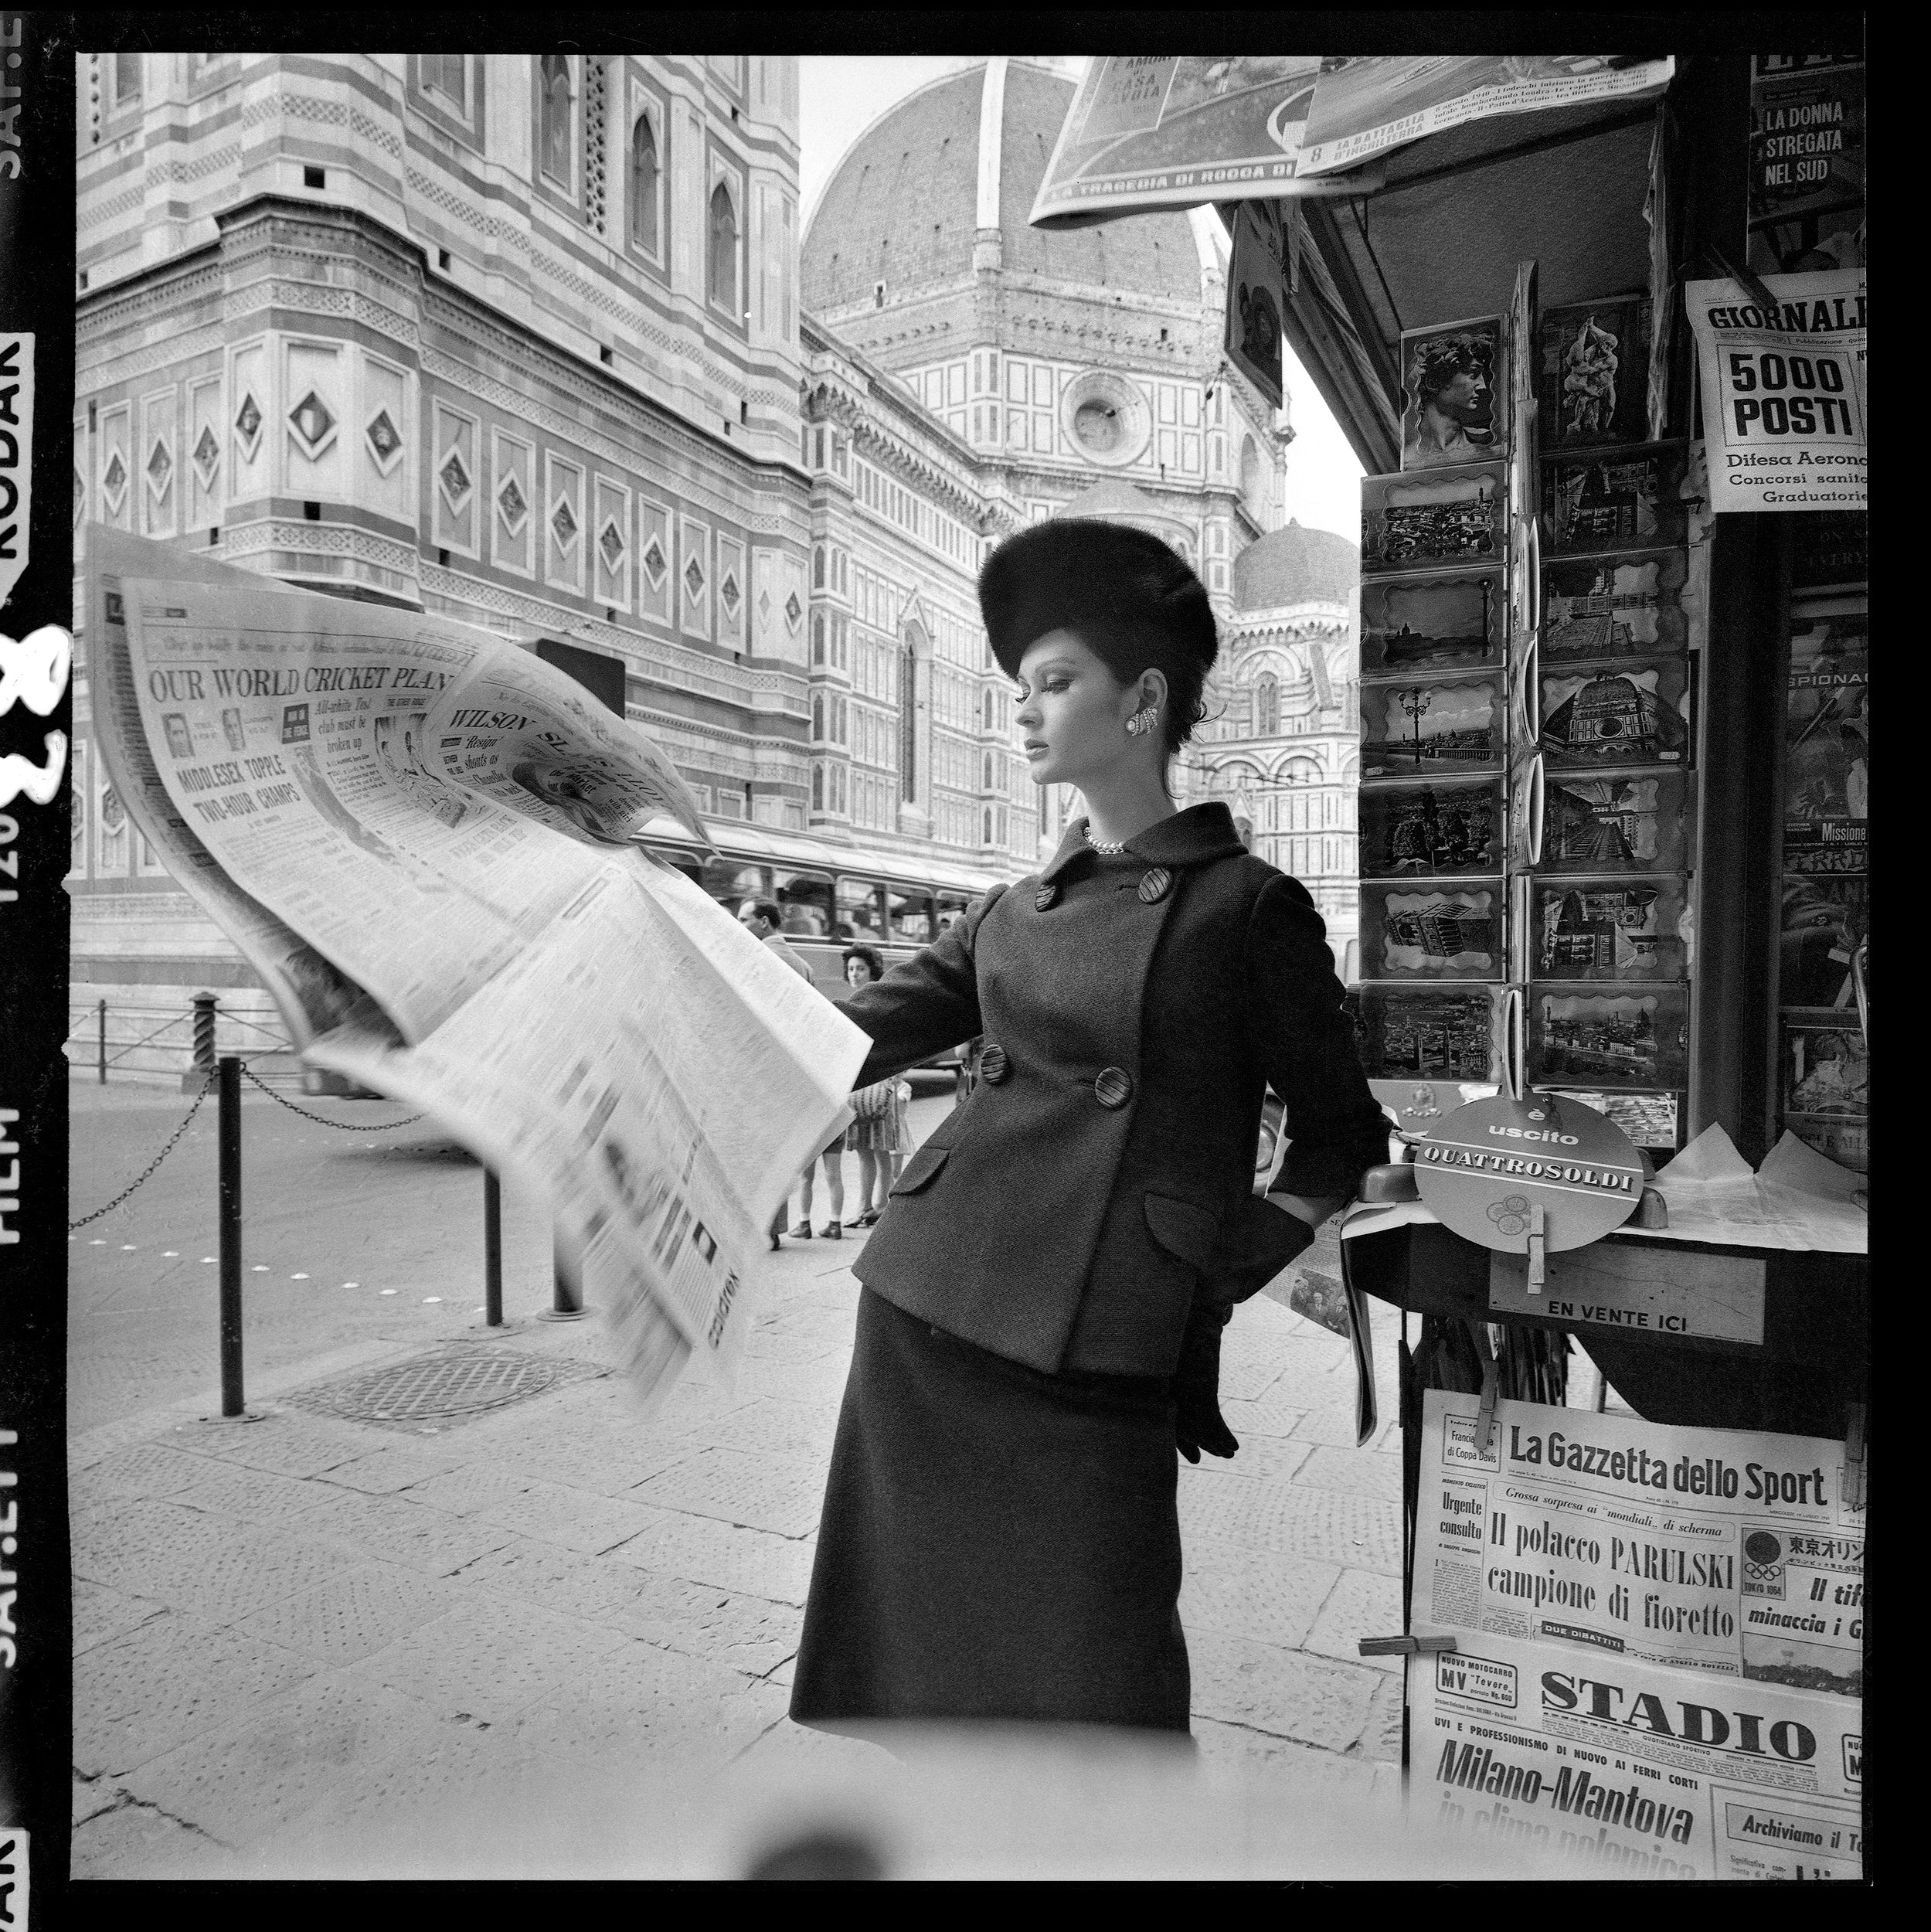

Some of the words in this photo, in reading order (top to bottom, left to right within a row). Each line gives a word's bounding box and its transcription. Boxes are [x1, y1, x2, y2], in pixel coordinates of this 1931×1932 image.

[1472, 90, 1490, 100] 1940
[1501, 83, 1538, 94] tedeschi
[1541, 79, 1575, 88] iniziano
[1461, 92, 1518, 111] bombardando
[1766, 109, 1786, 131] LA
[1789, 101, 1843, 129] DONNA
[1311, 147, 1322, 162] 8
[1337, 139, 1349, 150] LA
[1354, 113, 1425, 144] BATTAGLIA
[1334, 123, 1423, 161] D'INGHILTERRA
[1766, 129, 1843, 158] STREGATA
[1081, 175, 1168, 195] TRAGEDIA
[1175, 172, 1194, 186] DI
[1202, 165, 1265, 184] ROCCA
[1273, 162, 1294, 178] DI
[1765, 162, 1793, 186] NEL
[1797, 159, 1828, 182] SUD
[1729, 353, 1844, 393] 5000
[1733, 396, 1853, 437] POSTI
[1726, 453, 1793, 468] Difesa
[1729, 474, 1807, 486] Concorsi
[149, 669, 206, 703] OUR
[212, 668, 299, 697] WORLD
[304, 667, 390, 692] CRICKET
[390, 667, 455, 692] PLAN
[338, 716, 355, 732] must
[450, 709, 537, 730] WILSON
[327, 737, 351, 753] broken
[353, 738, 362, 751] up
[464, 753, 488, 770] shouts
[490, 754, 499, 765] as
[177, 760, 246, 794] MIDDLESEX
[244, 754, 287, 780] TOPPLE
[194, 792, 259, 824] TWO-HOUR
[257, 783, 301, 809] CHAMPS
[620, 809, 634, 823] girl
[1822, 822, 1867, 841] Missione
[1528, 1106, 1545, 1122] è
[1488, 1123, 1579, 1146] uscito
[1423, 1145, 1635, 1192] QUATTROSOLDI
[1548, 1300, 1574, 1317] EN
[1580, 1304, 1649, 1328] VENTE
[1659, 1315, 1688, 1332] ICI
[1451, 1430, 1475, 1444] Francia
[1447, 1446, 1454, 1457] di
[1456, 1447, 1477, 1461] Coppa
[1478, 1451, 1497, 1463] Davis
[1510, 1425, 1542, 1464] La
[1548, 1431, 1668, 1490] Gazzetta
[1673, 1455, 1739, 1499] dello
[1744, 1461, 1828, 1506] Sport
[1442, 1478, 1464, 1486] MOMENTO
[1465, 1481, 1486, 1490] CICLISTICO
[1442, 1492, 1482, 1515] Urgente
[1506, 1486, 1539, 1502] Grossa
[1543, 1495, 1583, 1512] sorpresa
[1587, 1504, 1598, 1514] ai
[1663, 1519, 1674, 1531] di
[1678, 1522, 1722, 1536] scherma
[1440, 1519, 1482, 1540] consulto
[1491, 1512, 1506, 1548] Il
[1515, 1519, 1601, 1566] polacco
[1610, 1536, 1736, 1592] PARULSKI
[1743, 1582, 1765, 1594] TOKYO
[1766, 1585, 1782, 1596] 1964
[1810, 1577, 1828, 1601] Il
[1834, 1583, 1864, 1607] tif
[1487, 1563, 1596, 1612] campione
[1608, 1583, 1630, 1624] di
[1644, 1592, 1736, 1639] fioretto
[1748, 1607, 1827, 1634] minaccia
[1833, 1617, 1842, 1635] i
[1545, 1625, 1567, 1636] DUE
[1571, 1630, 1621, 1648] DIBATTITI
[1441, 1656, 1466, 1667] NUOVO
[1468, 1662, 1513, 1678] MOTOCARRO
[1669, 1658, 1698, 1668] ANGELO
[1702, 1662, 1735, 1672] ROVELLI
[1441, 1668, 1467, 1690] MV
[1501, 1693, 1513, 1702] 600
[1541, 1670, 1817, 1762] STADIO
[1434, 1716, 1451, 1729] UVI
[1457, 1722, 1464, 1732] E
[1470, 1725, 1549, 1751] PROFESSIONISMO
[1556, 1744, 1567, 1757] DI
[1574, 1748, 1607, 1767] NUOVO
[1615, 1759, 1626, 1771] AI
[1634, 1764, 1661, 1781] FERRI
[1668, 1773, 1698, 1791] CORTI
[1643, 1734, 1681, 1750] QUOTIDIANO
[1682, 1743, 1712, 1757] SPORTIVO
[1436, 1739, 1695, 1845] Milano-Mantova
[1440, 1790, 1466, 1825] in
[1742, 1815, 1823, 1845] Archiviamo
[1831, 1831, 1841, 1849] il
[1730, 1854, 1766, 1869] Significativo
